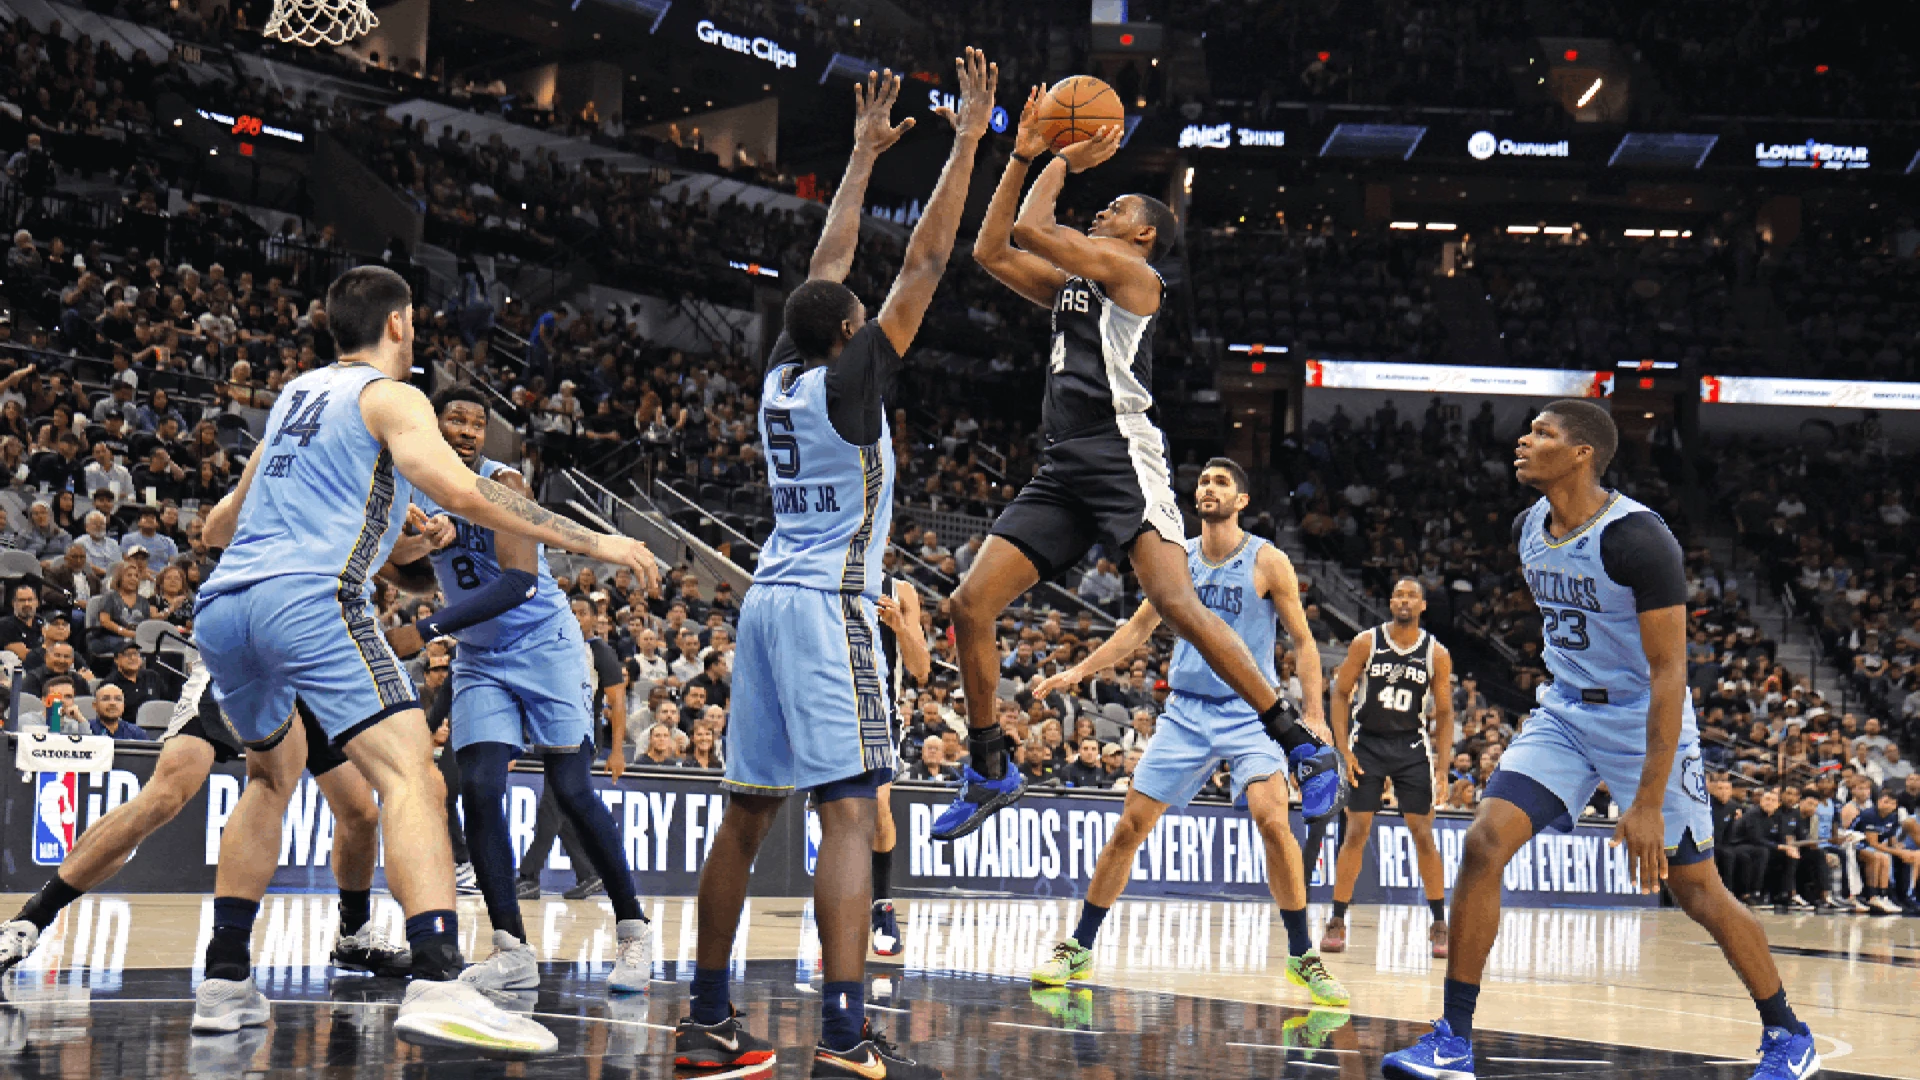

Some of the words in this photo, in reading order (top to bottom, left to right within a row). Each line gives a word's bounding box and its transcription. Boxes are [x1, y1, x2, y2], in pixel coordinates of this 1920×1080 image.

[696, 19, 751, 55] Great
[752, 37, 797, 70] Clips
[271, 389, 331, 447] 14
[763, 407, 800, 479] 5
[814, 484, 841, 513] JR.
[452, 555, 481, 591] 8
[1541, 606, 1591, 651] 23
[1378, 685, 1413, 712] 40
[31, 749, 93, 760] GATORADE
[1536, 834, 1599, 893] EVERY
